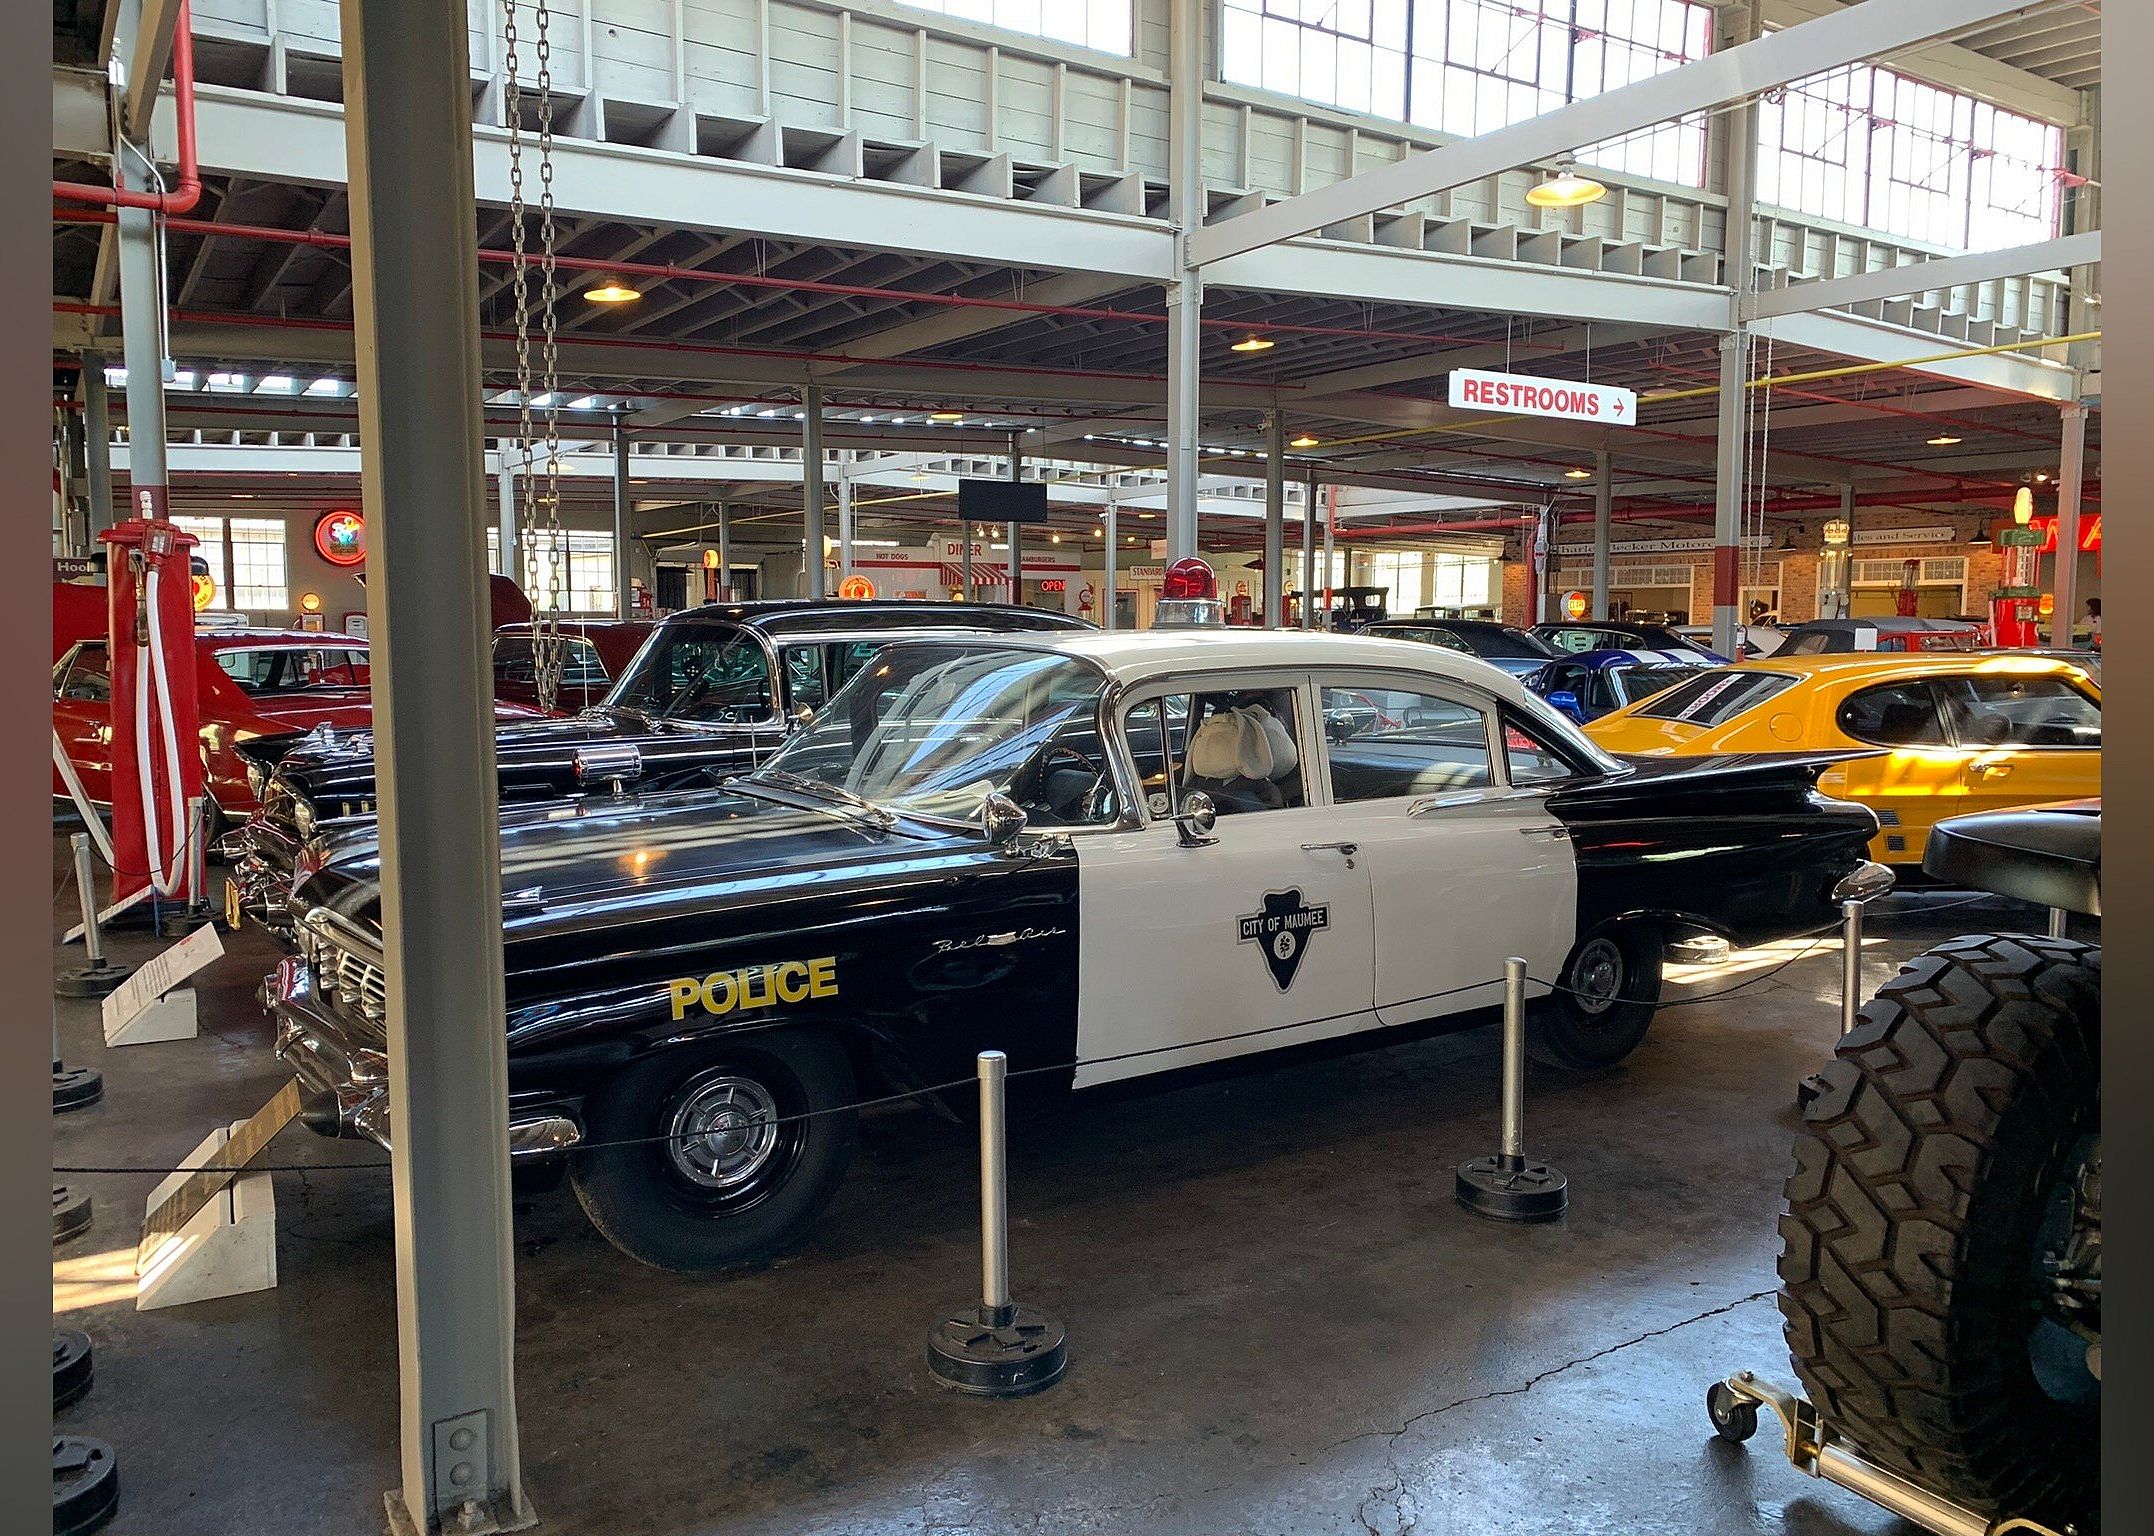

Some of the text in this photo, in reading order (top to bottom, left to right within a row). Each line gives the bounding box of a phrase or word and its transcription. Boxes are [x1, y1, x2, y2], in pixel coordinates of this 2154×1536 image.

[1463, 378, 1600, 416] RESTROOMS
[876, 552, 909, 561] HOT DOGS
[1041, 580, 1066, 591] OPEN
[1242, 910, 1325, 936] CITY OF MAUMEE
[669, 956, 839, 1021] POLICE
